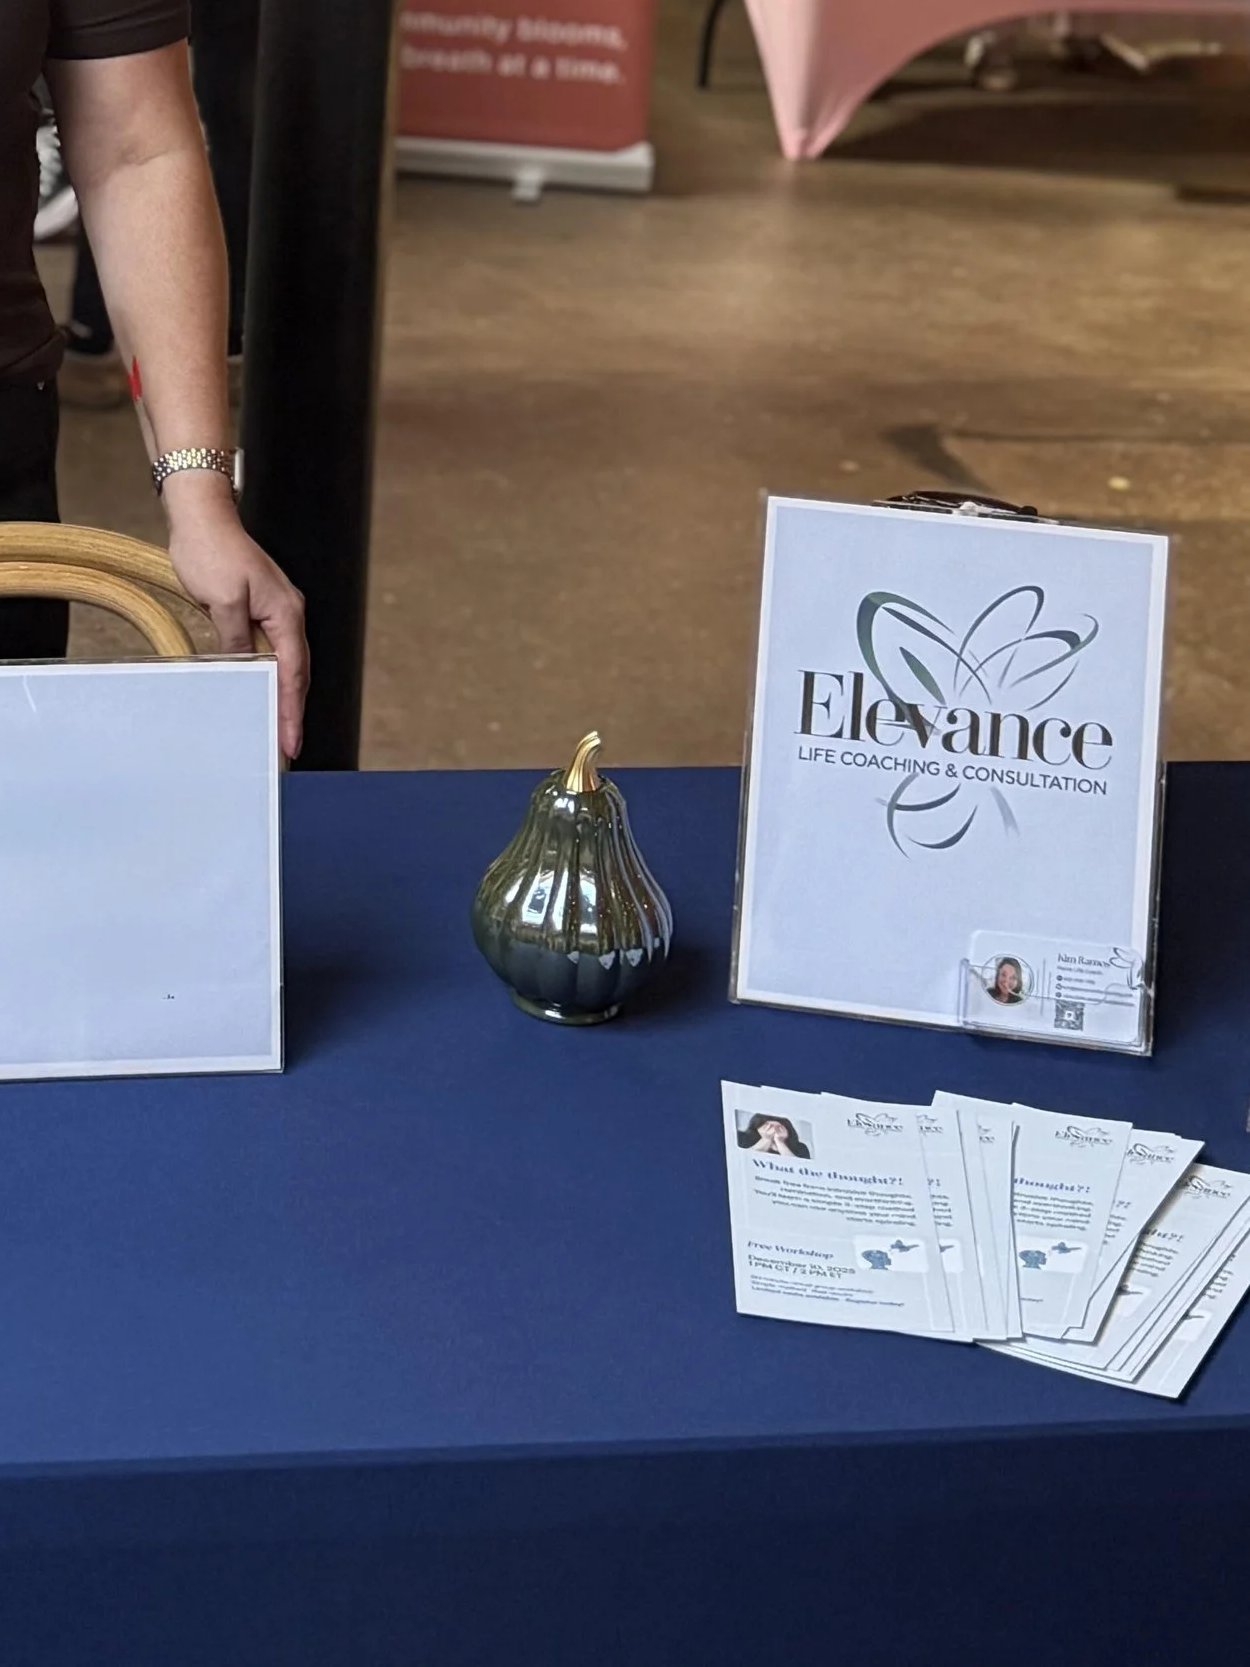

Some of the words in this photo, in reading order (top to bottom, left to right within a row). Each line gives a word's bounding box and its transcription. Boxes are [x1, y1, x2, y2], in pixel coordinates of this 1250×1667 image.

[498, 52, 526, 77] at
[530, 56, 550, 79] a
[794, 670, 1113, 770] Elevance
[798, 745, 835, 764] LIFE
[840, 751, 940, 776] COACHING
[945, 762, 959, 778] &
[962, 765, 1108, 795] CONSULTATION
[753, 1158, 793, 1174] What
[799, 1167, 823, 1177] the
[828, 1171, 903, 1186] thought?!
[747, 1240, 774, 1251] Free
[775, 1244, 834, 1260] Workshop
